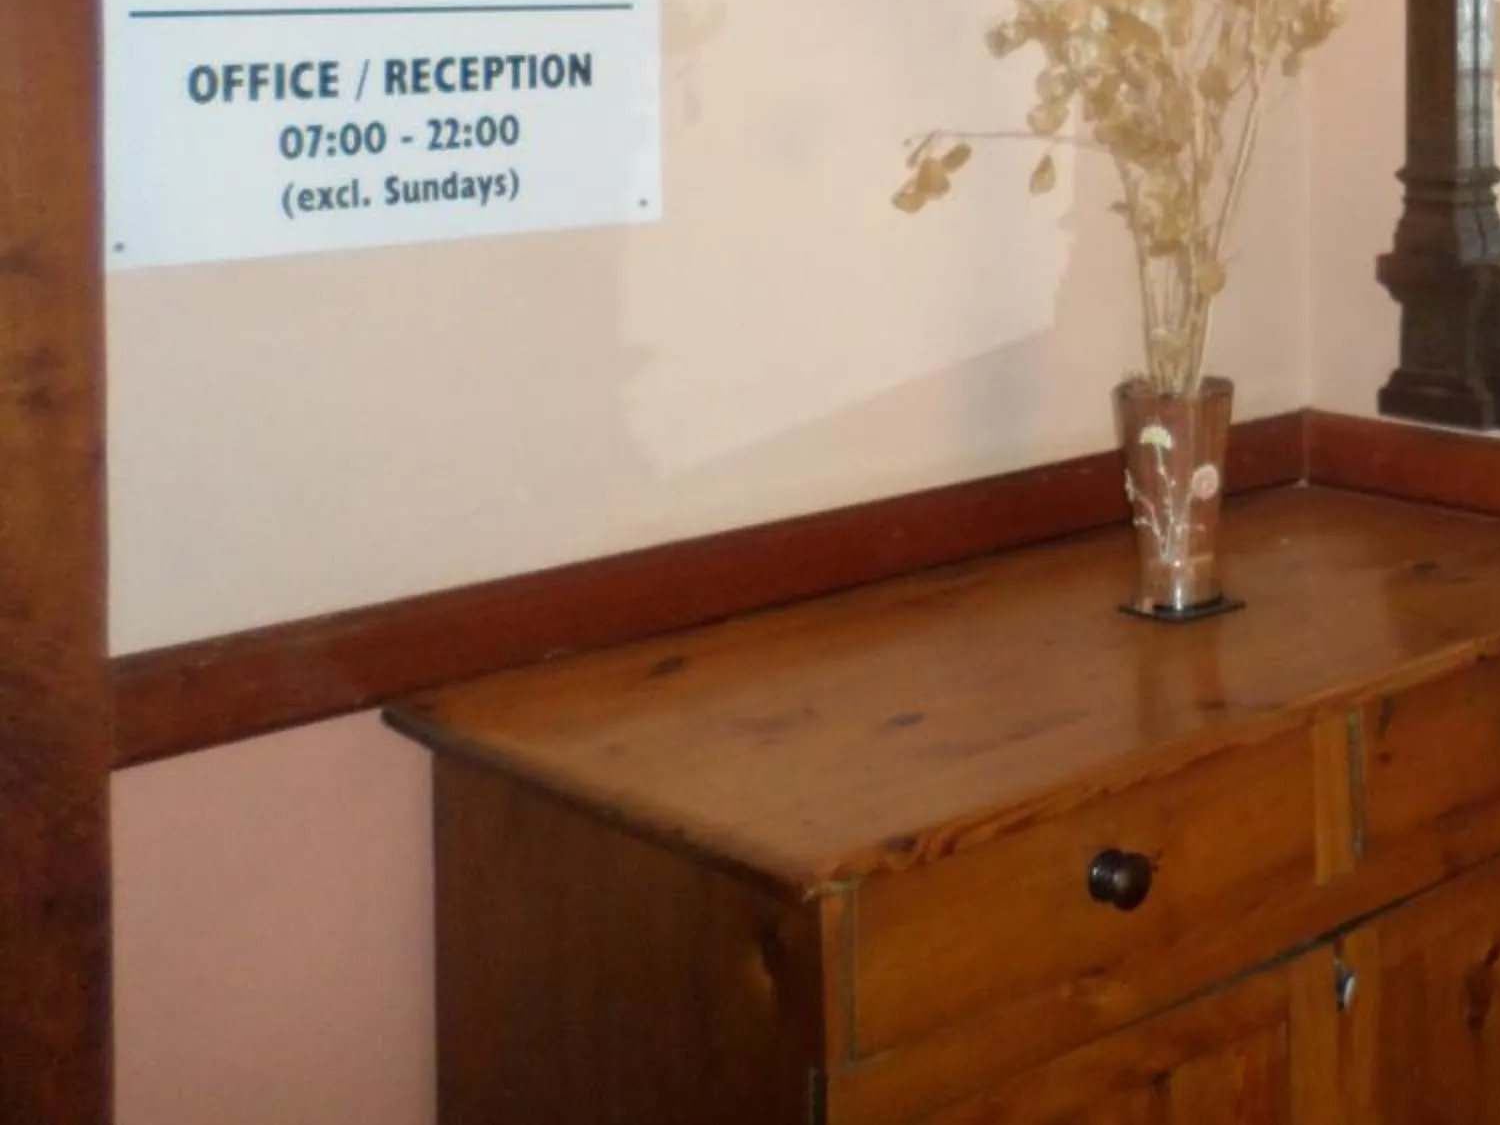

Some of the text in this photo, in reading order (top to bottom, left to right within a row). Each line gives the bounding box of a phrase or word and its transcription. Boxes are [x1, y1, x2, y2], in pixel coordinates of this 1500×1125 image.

[187, 60, 340, 104] OFFICE
[384, 53, 593, 96] RECEPTION
[279, 121, 387, 160] 07:00
[427, 114, 520, 152] 22:00
[281, 168, 520, 219] (excl. Sundays)
